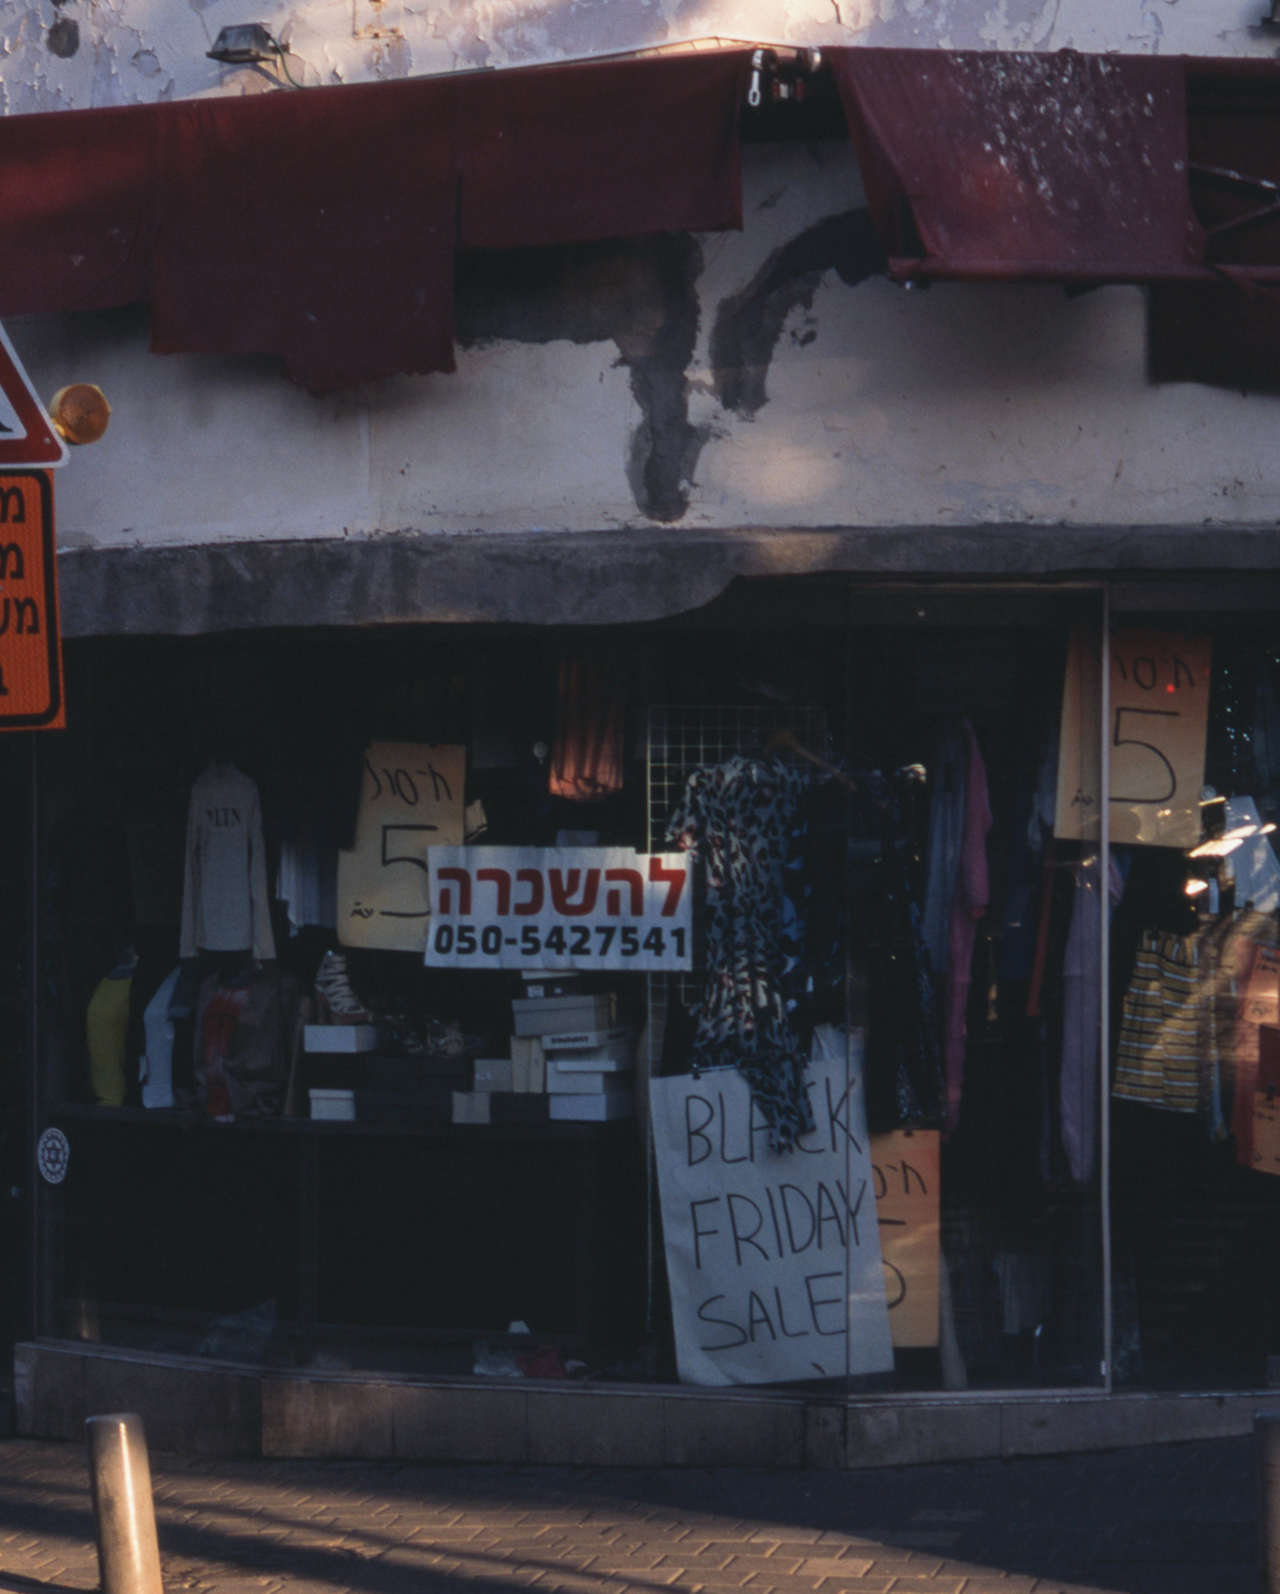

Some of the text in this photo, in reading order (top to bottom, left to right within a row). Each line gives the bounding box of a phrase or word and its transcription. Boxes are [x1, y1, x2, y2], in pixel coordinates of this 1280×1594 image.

[1108, 707, 1181, 804] 5
[380, 824, 439, 918] 5
[436, 857, 687, 918] להשכרה
[433, 924, 686, 957] 050-5427541
[690, 1180, 867, 1270] FRIDAY
[697, 1271, 848, 1352] SALE
